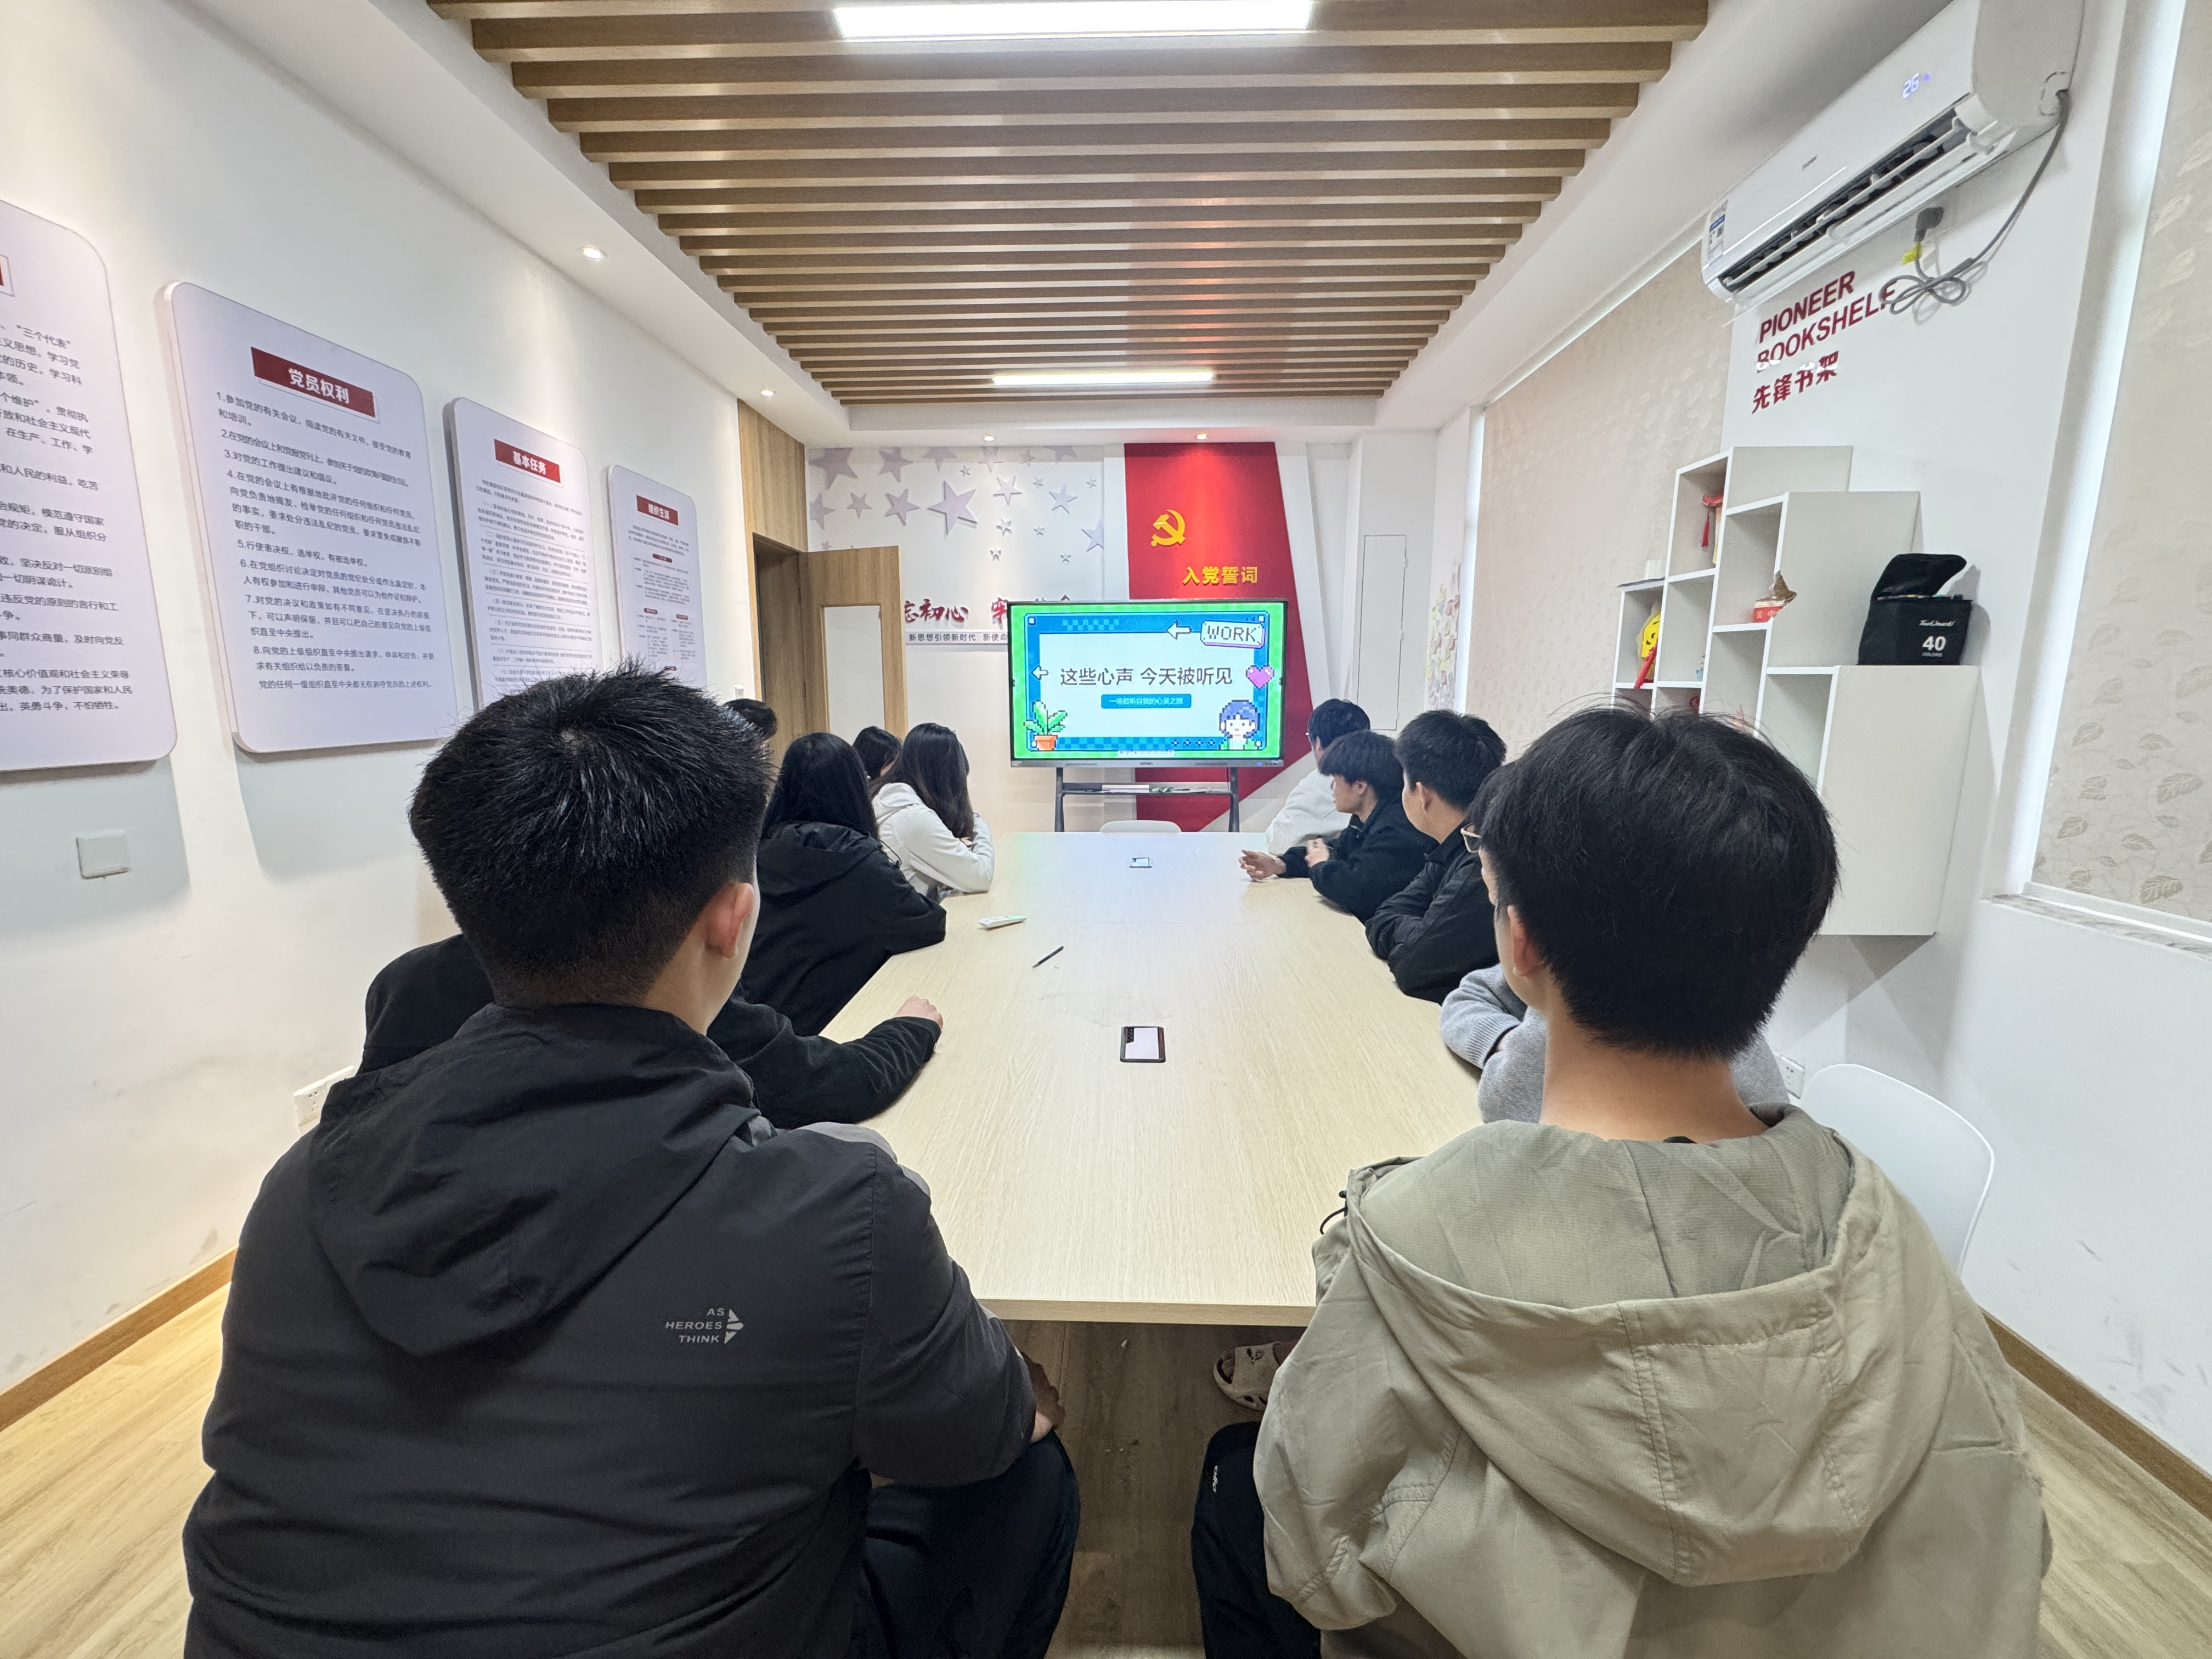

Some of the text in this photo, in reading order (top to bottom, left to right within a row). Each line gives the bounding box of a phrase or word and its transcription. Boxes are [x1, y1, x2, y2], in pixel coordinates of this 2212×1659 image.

[1902, 72, 1920, 99] 26
[1759, 270, 1855, 343] PIONEER
[0, 354, 82, 386] 的历史，学习科
[288, 368, 351, 405] 党员权利
[1752, 350, 1839, 414] 先锋书架
[0, 408, 91, 439] 放和社会主义现代
[512, 450, 547, 476] 基本任务
[0, 572, 74, 589] 一切阴谋诡计。
[1182, 566, 1258, 585] 入党誓词
[0, 610, 20, 620] 争。
[909, 633, 1008, 642] 新思想引领新时代 新使命
[1206, 625, 1257, 642] WORK
[1922, 636, 1946, 651] 40
[0, 668, 130, 680] 核心价值观和社会主义荣辱
[1060, 667, 1233, 687] 这些心声 今天被听见
[707, 1307, 725, 1316] AS
[665, 1321, 723, 1330] HEROES
[679, 1335, 720, 1343] THINK
